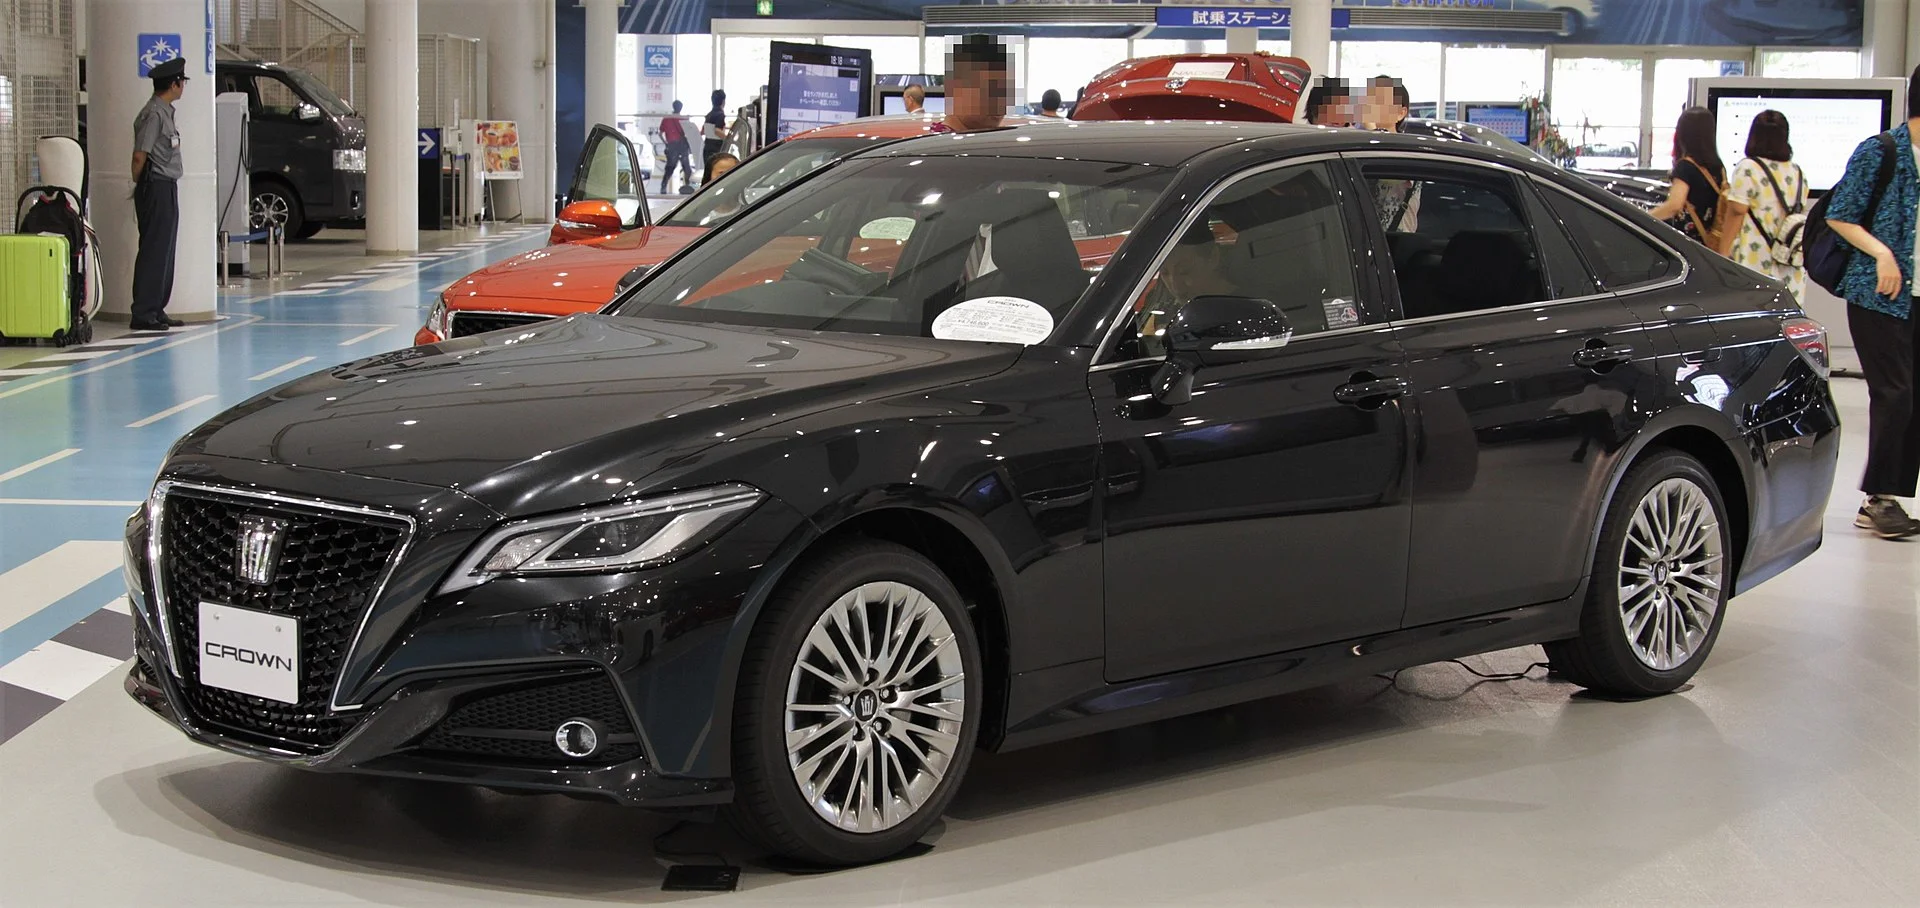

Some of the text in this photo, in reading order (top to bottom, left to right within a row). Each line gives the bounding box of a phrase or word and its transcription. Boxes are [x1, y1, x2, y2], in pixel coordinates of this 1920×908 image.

[1192, 11, 1291, 25] 試乗ステーシ
[987, 300, 1030, 308] CROWN
[205, 641, 292, 672] CROWN
